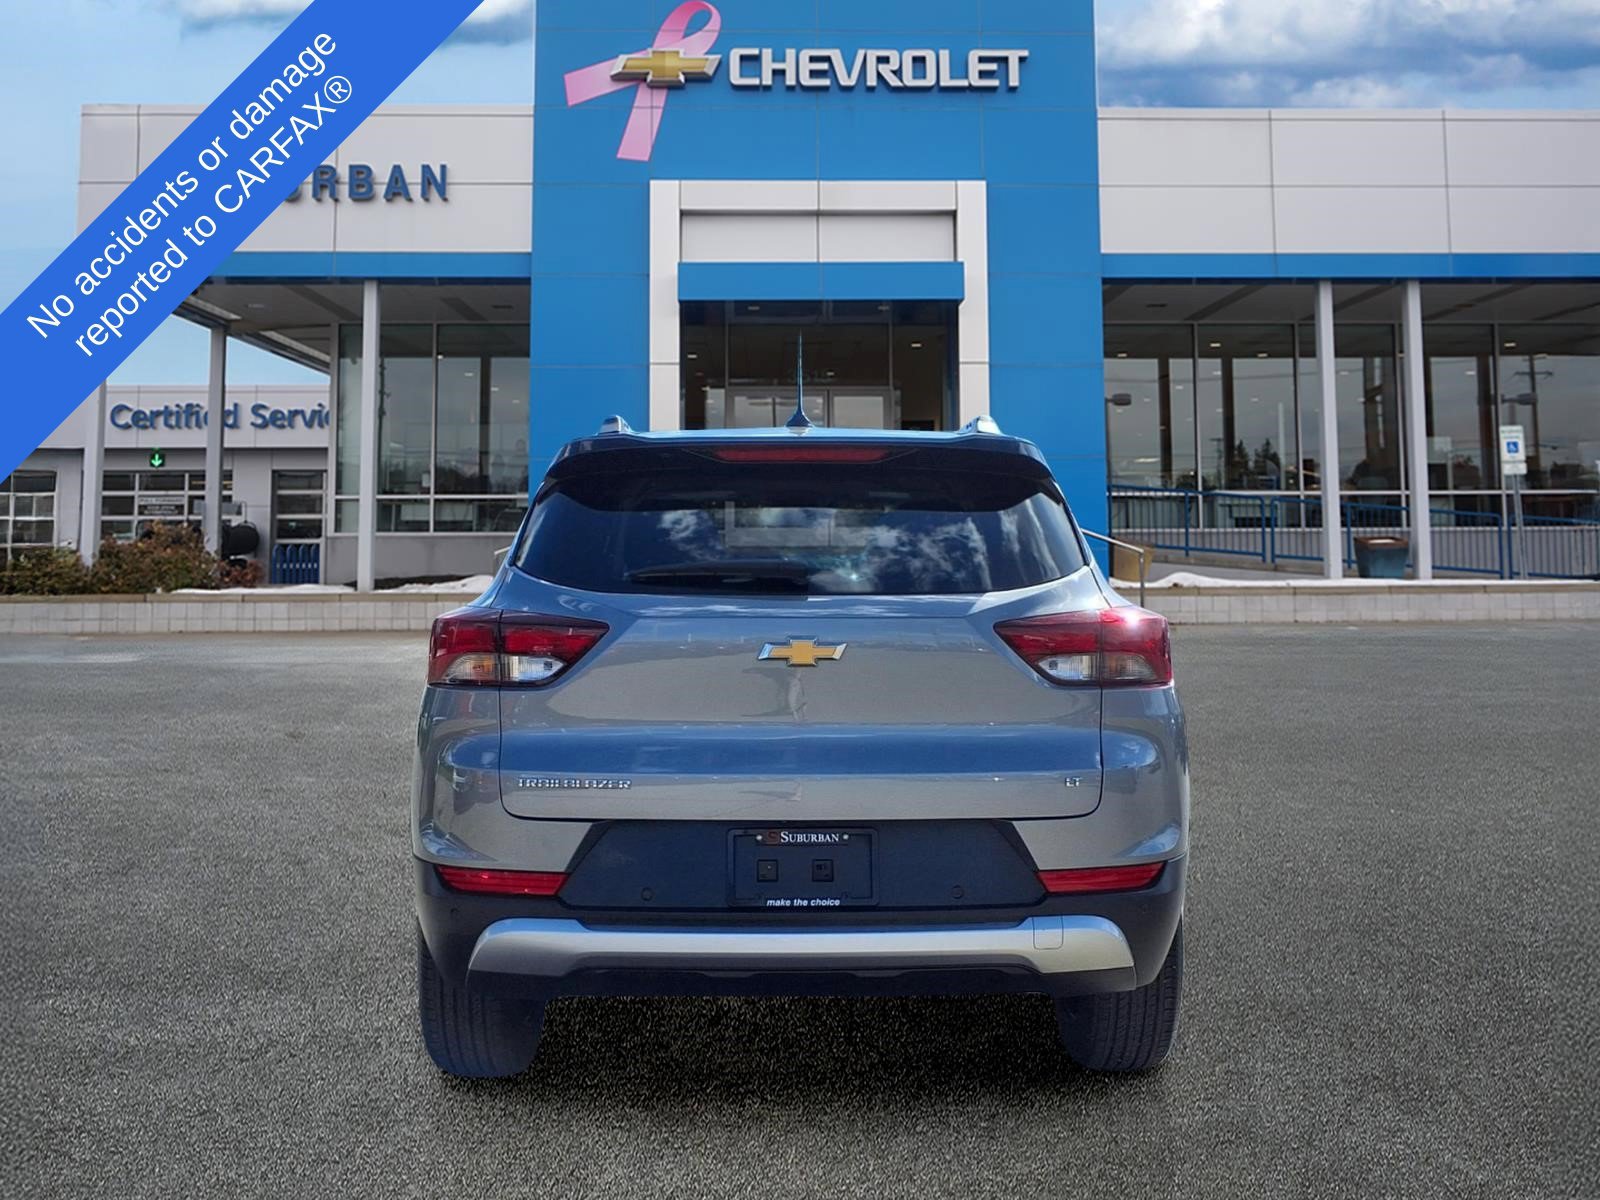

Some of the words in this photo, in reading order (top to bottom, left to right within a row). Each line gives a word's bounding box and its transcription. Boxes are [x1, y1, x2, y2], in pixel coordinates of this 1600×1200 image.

[729, 48, 1029, 88] CHEVROLET
[517, 777, 631, 789] TRAILBLAZER
[780, 831, 839, 843] SUBURBAN
[766, 898, 791, 907] make
[793, 898, 808, 907] the
[810, 898, 841, 907] choice
